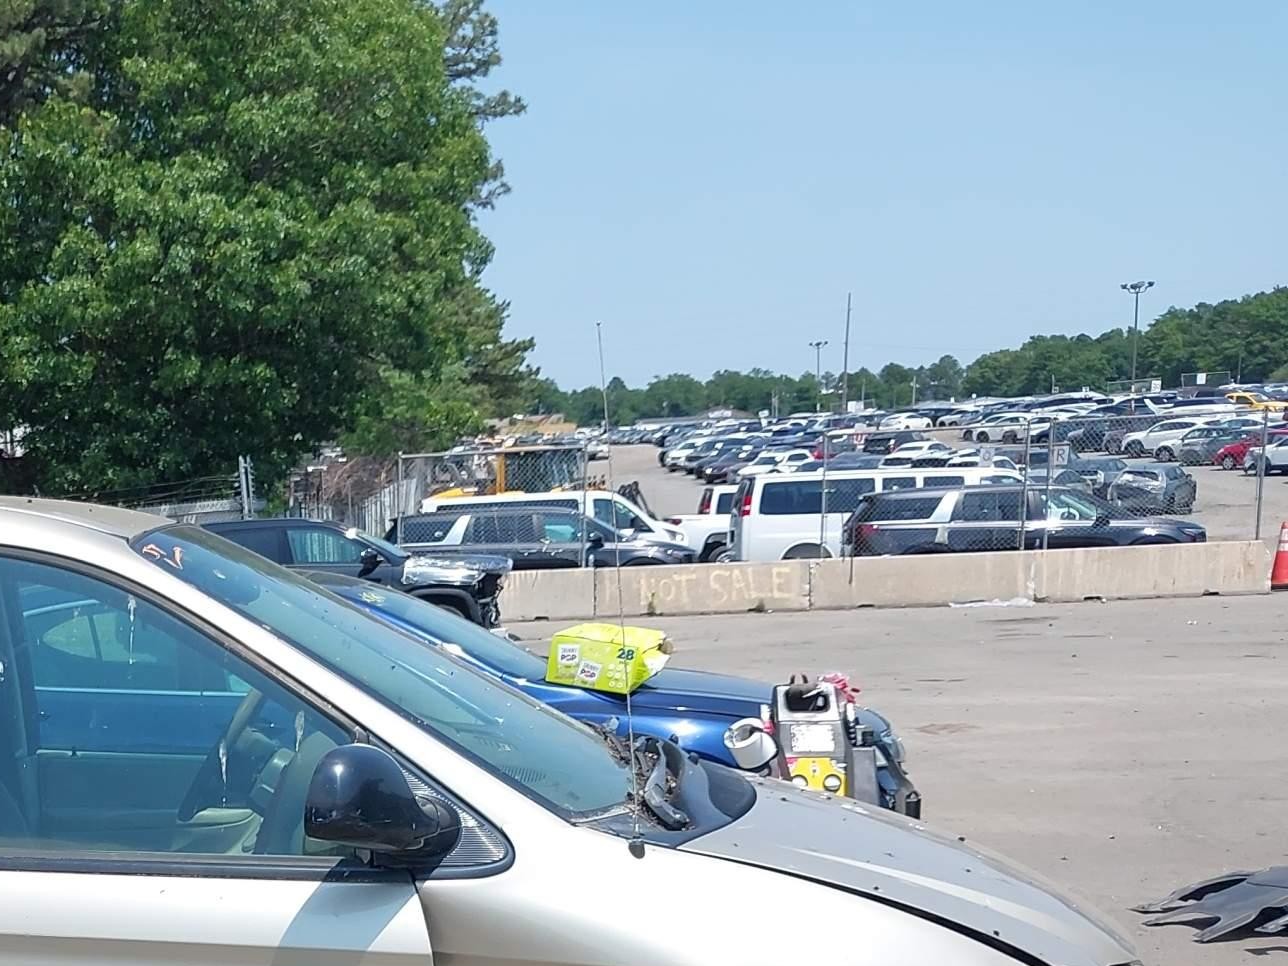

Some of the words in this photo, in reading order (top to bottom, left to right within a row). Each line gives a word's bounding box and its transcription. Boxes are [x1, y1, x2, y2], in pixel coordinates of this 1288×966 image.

[1056, 448, 1065, 461] R
[639, 573, 696, 605] NOT
[710, 566, 793, 602] SALE
[617, 648, 635, 660] 28
